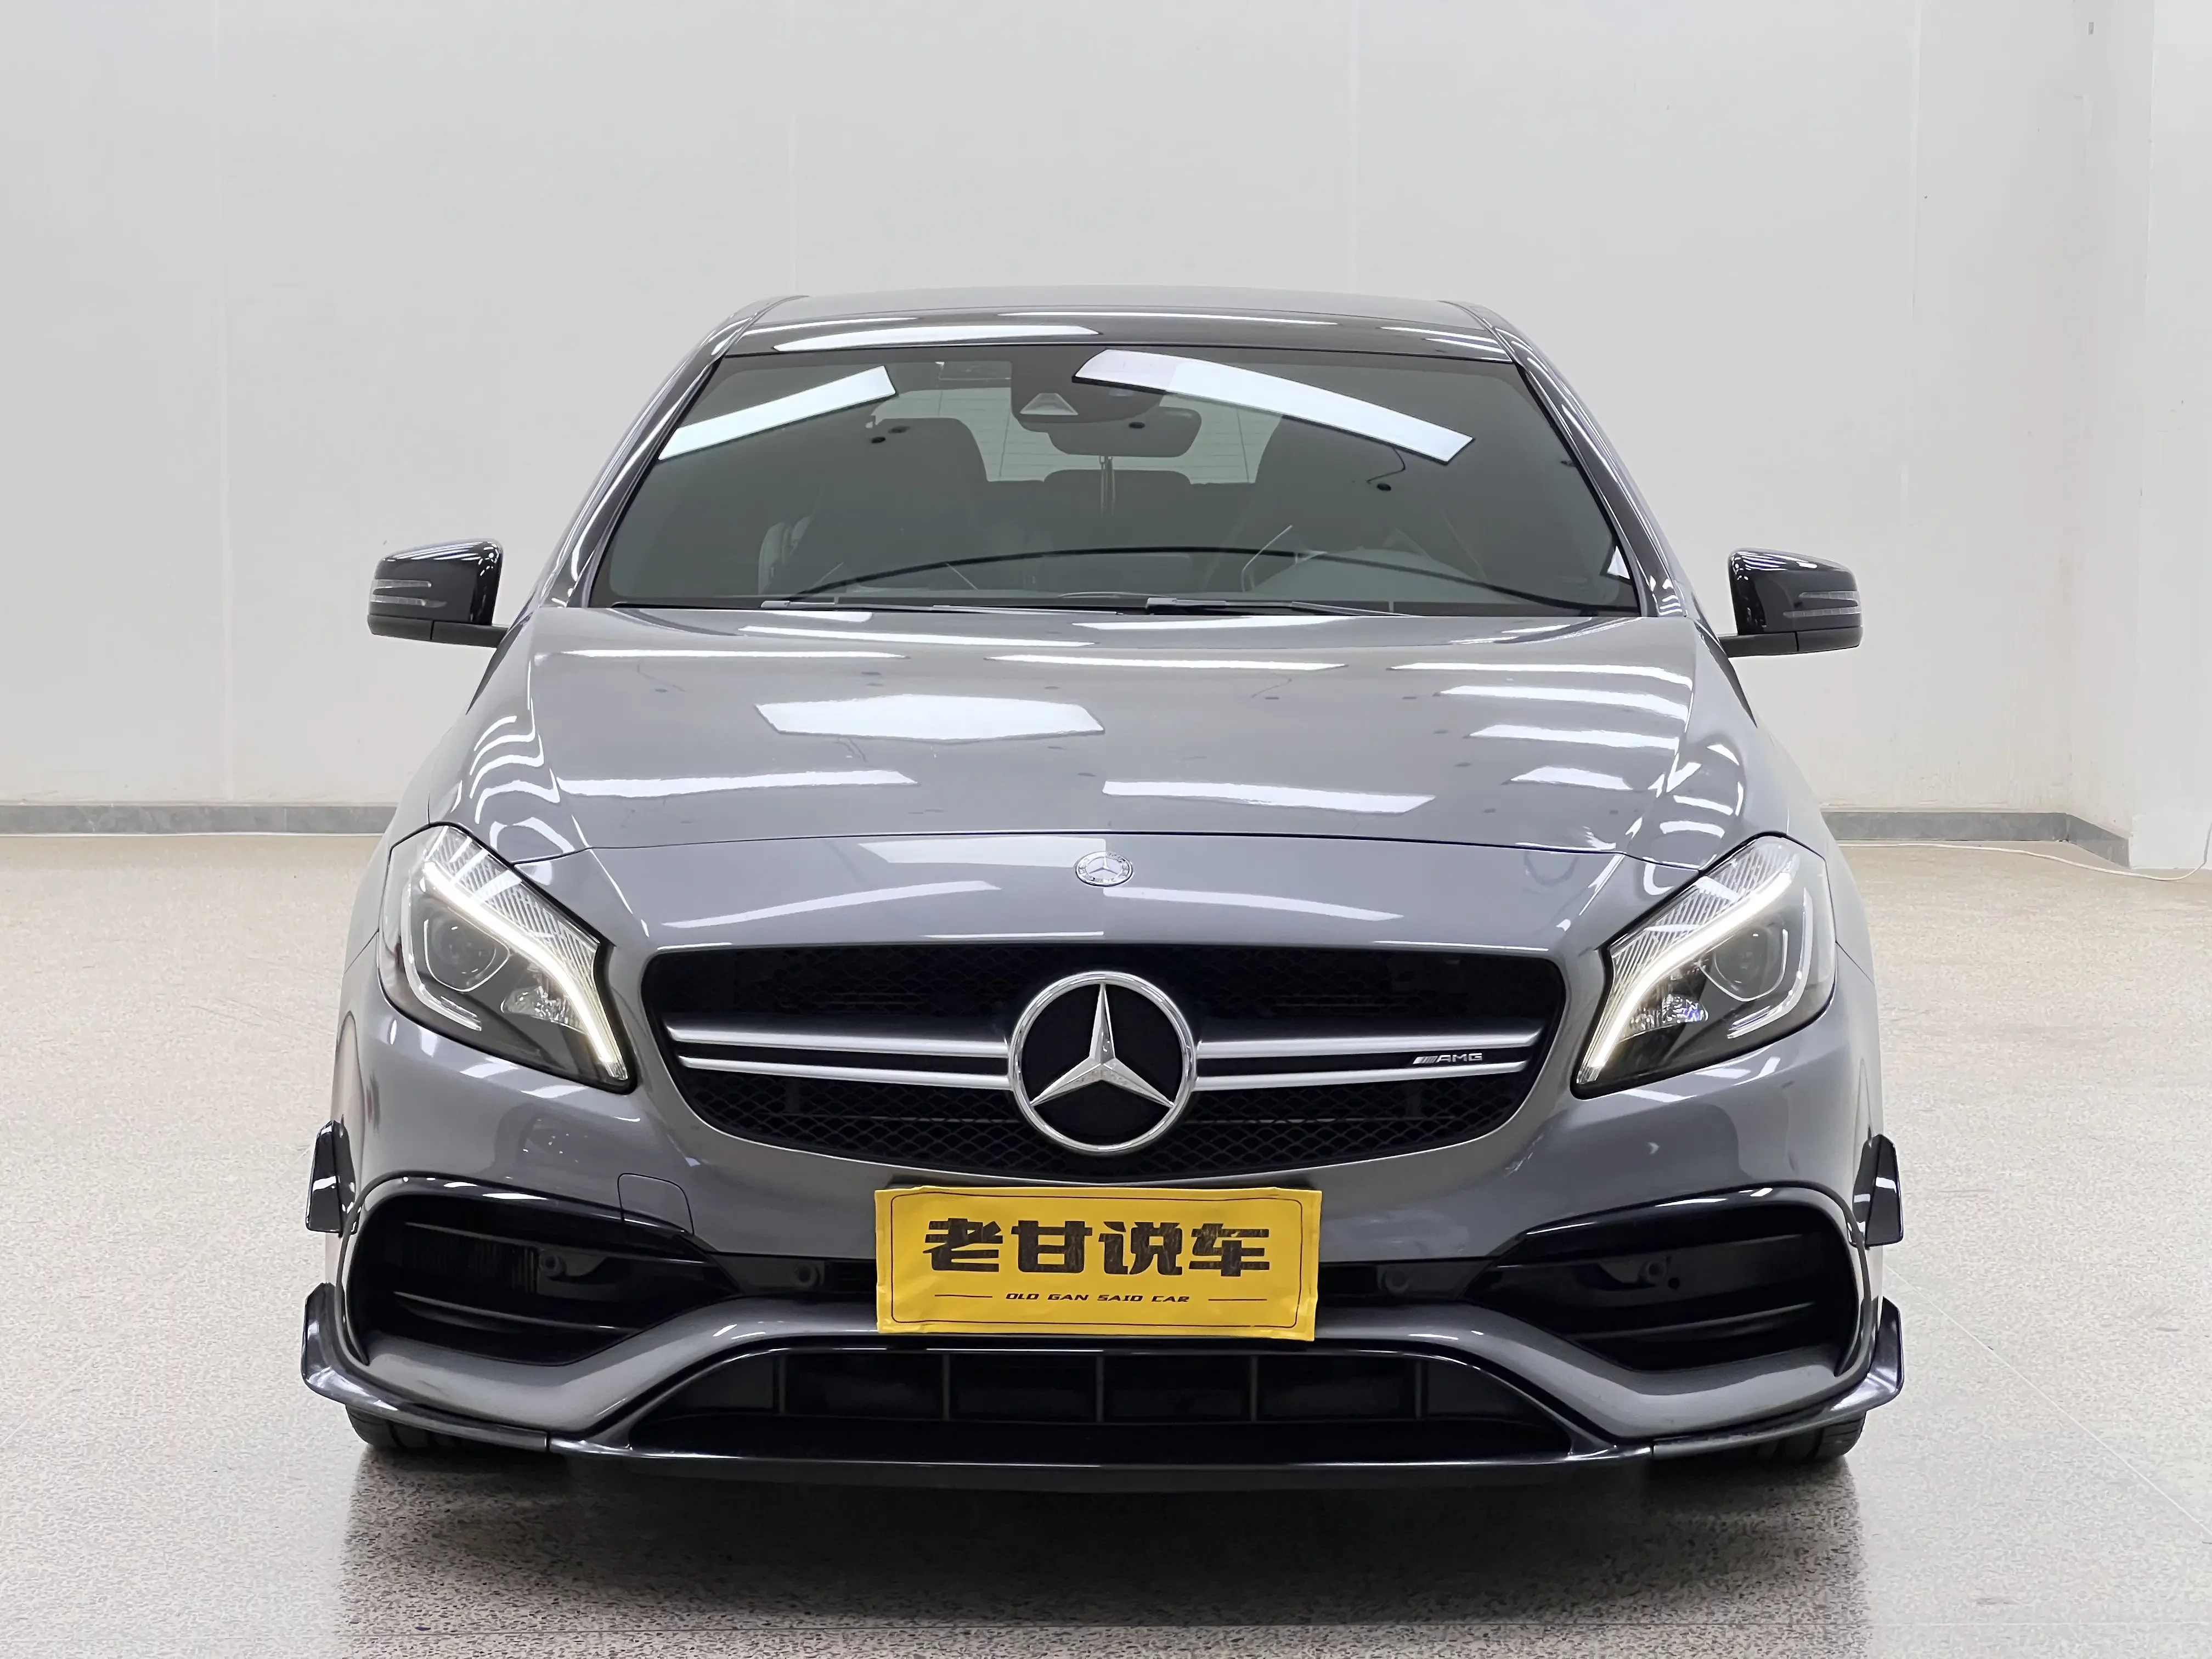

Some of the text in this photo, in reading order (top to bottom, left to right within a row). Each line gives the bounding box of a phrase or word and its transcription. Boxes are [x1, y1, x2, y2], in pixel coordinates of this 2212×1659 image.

[1435, 1052, 1483, 1063] AMG
[922, 1217, 1271, 1278] 老甘说车
